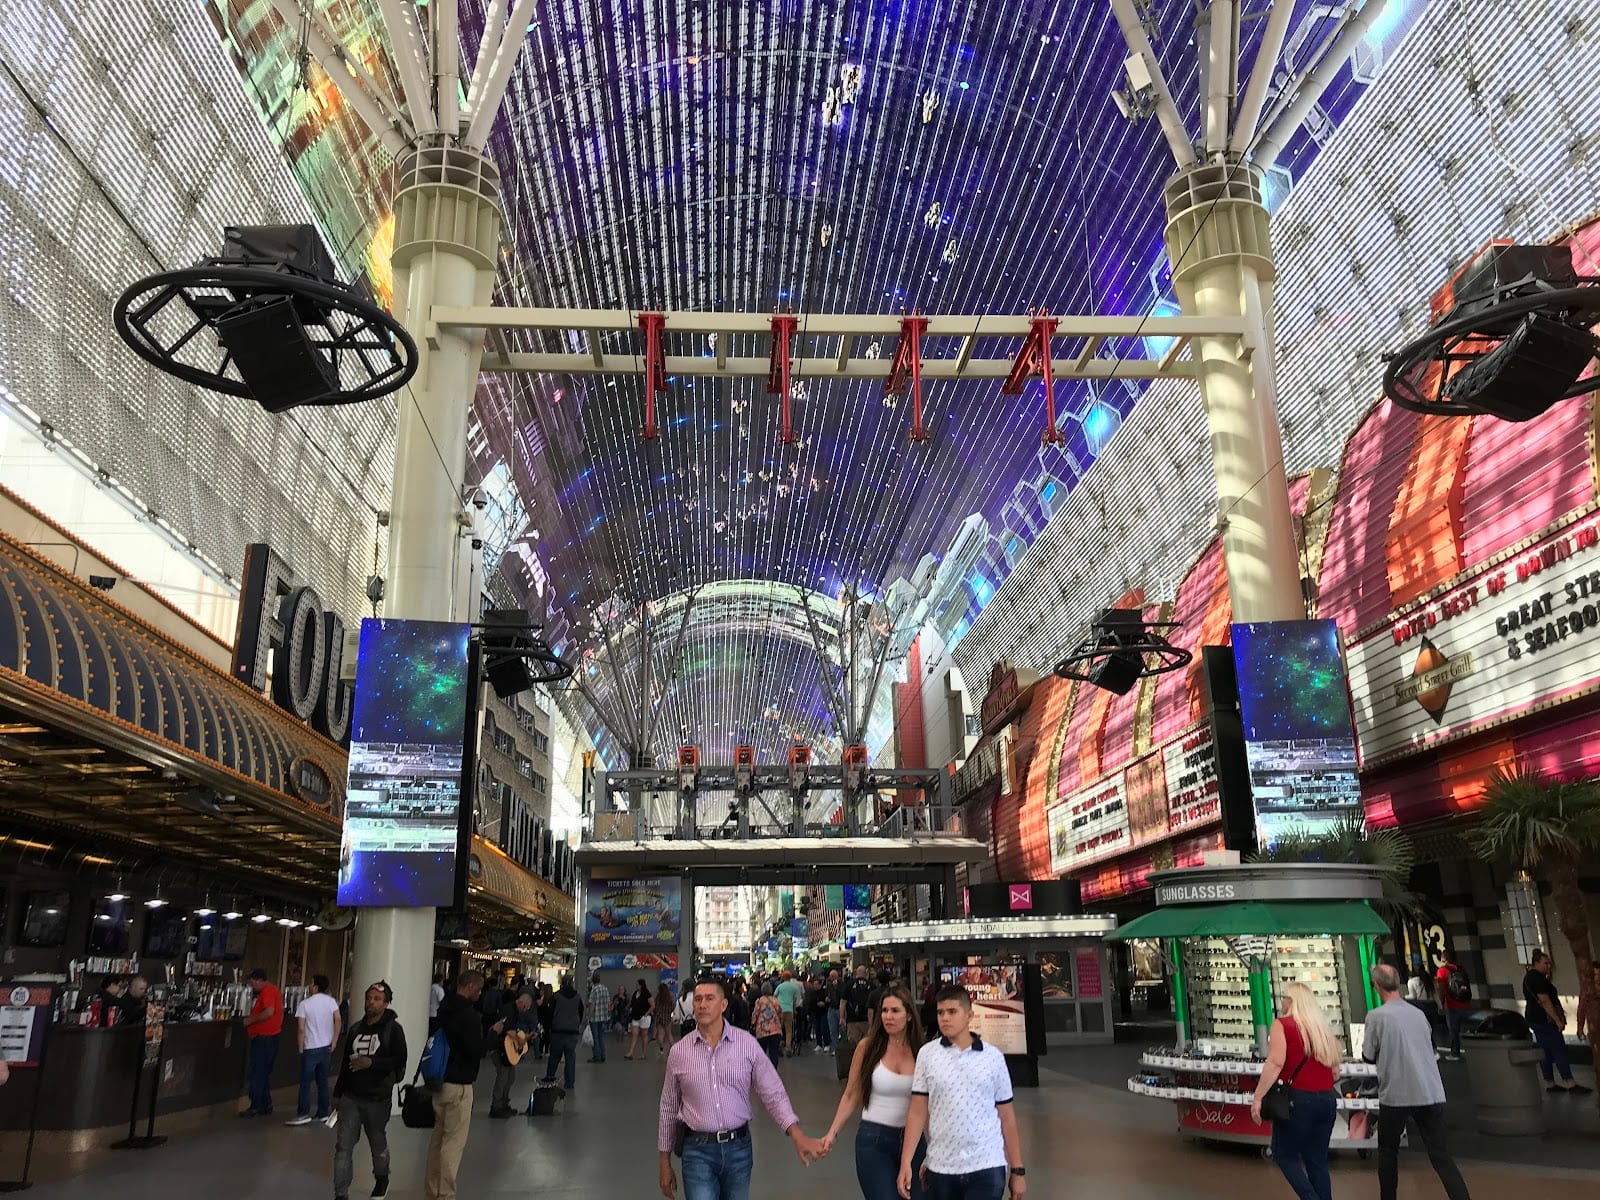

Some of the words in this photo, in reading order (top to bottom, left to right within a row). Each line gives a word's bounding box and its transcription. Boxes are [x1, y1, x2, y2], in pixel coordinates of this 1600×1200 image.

[1496, 592, 1554, 637] GREAT
[607, 880, 631, 888] TICKETS
[632, 879, 646, 887] SOLD
[647, 879, 661, 887] HERE
[1162, 884, 1235, 901] SUNGLASSES
[950, 923, 1012, 935] CHIPPENDALES
[1423, 924, 1448, 968] $3
[1195, 1103, 1235, 1126] Sale
